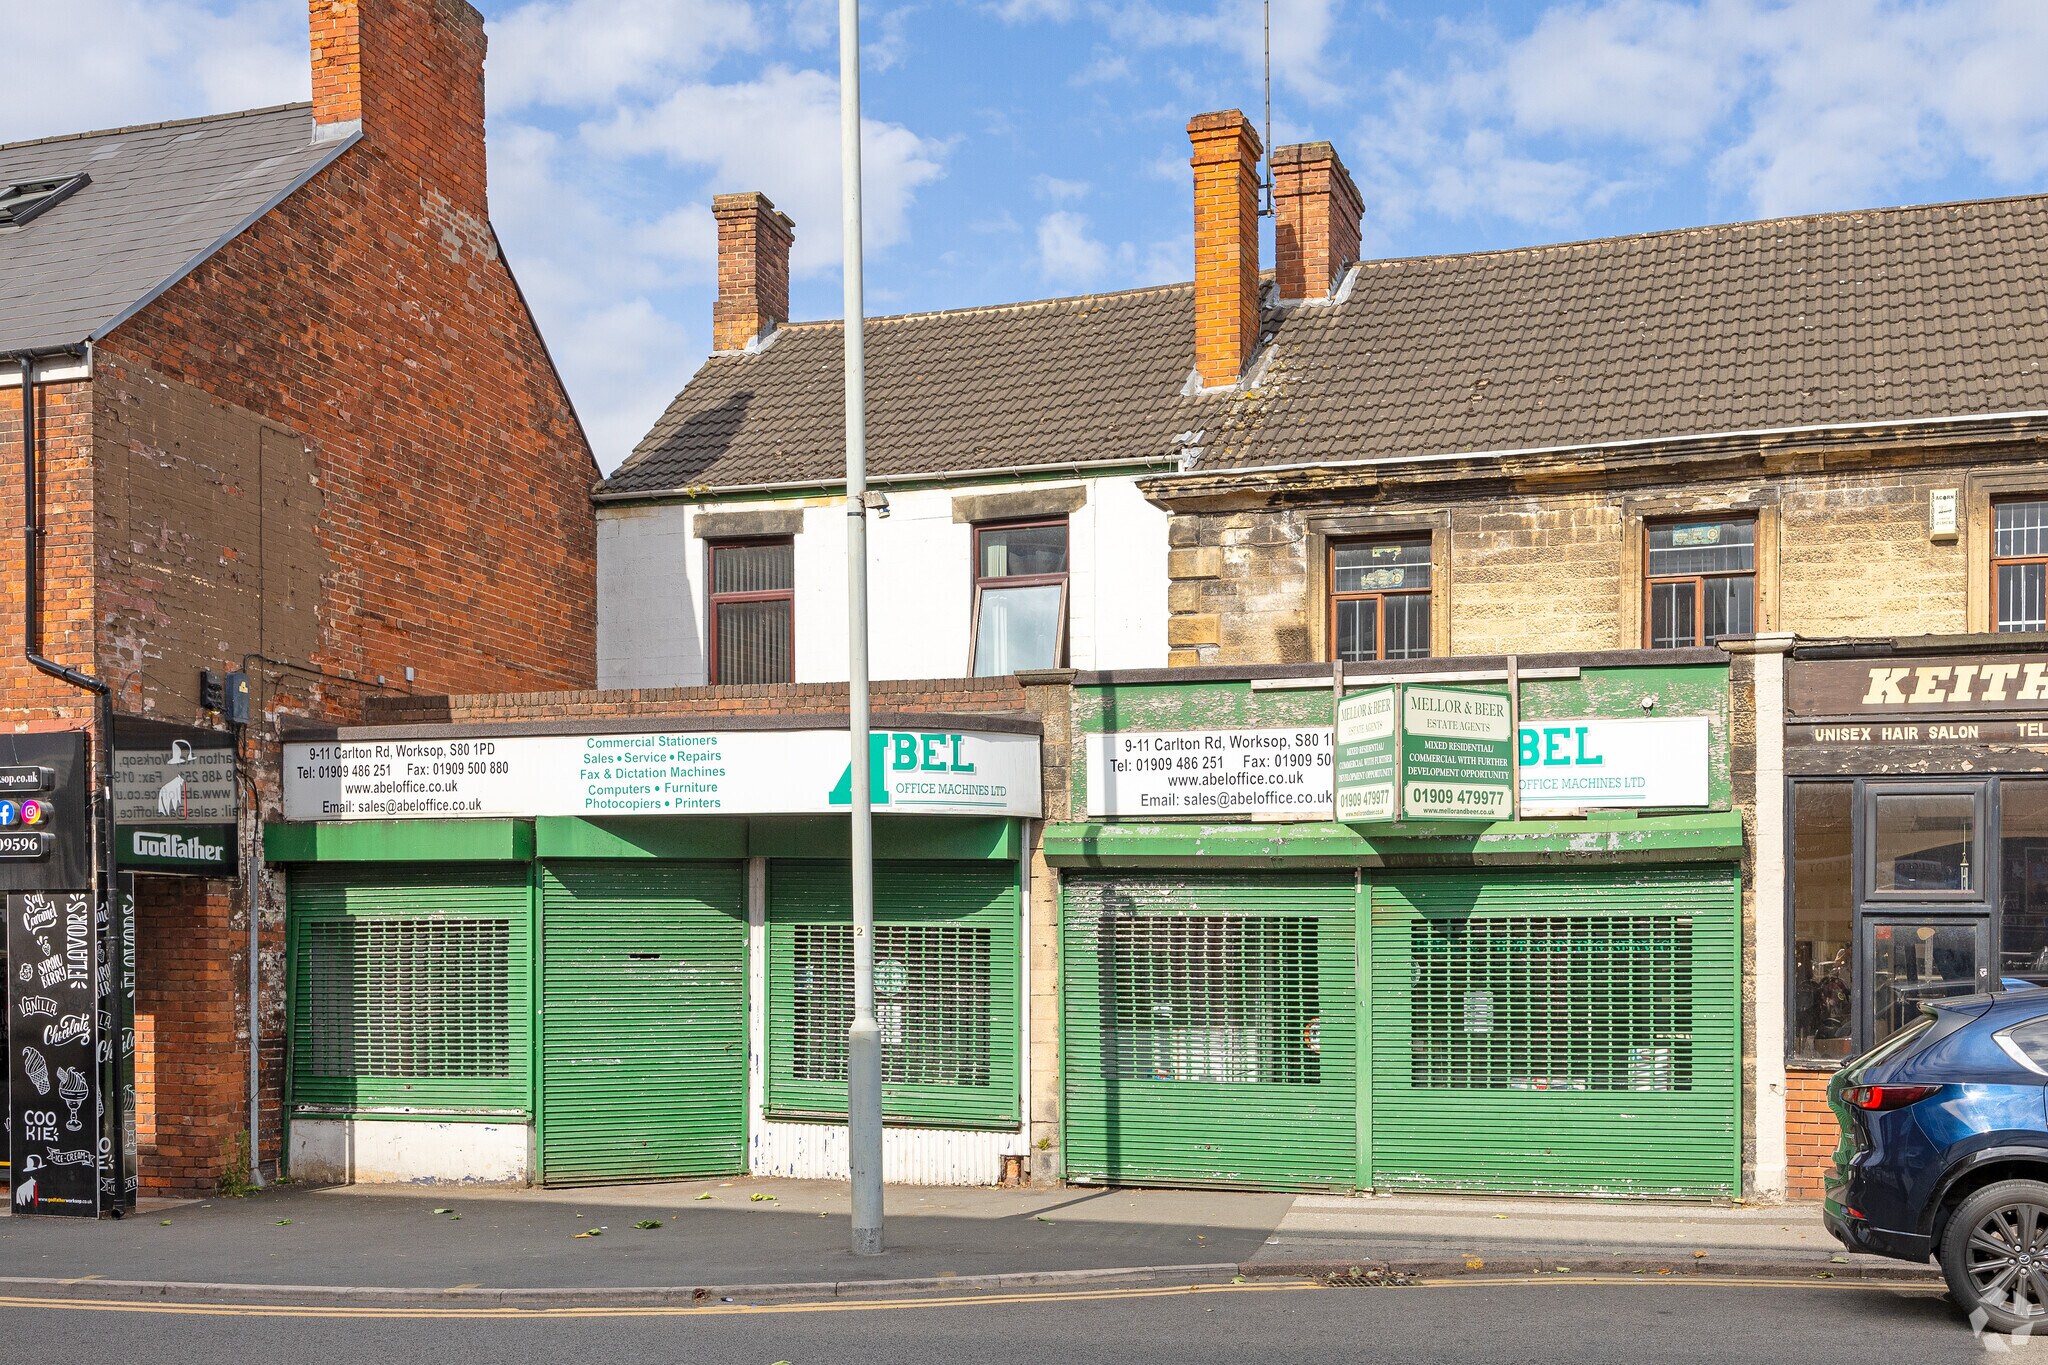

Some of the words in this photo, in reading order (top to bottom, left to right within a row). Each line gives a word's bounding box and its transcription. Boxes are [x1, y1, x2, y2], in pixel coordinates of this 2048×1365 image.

[1862, 662, 2048, 705] KEITH
[1341, 702, 1367, 722] MELLOR
[1368, 702, 1373, 716] &
[1374, 698, 1391, 714] BEER
[1411, 696, 1462, 713] MELLOR
[1464, 701, 1472, 714] &
[1474, 702, 1504, 718] BEER
[1427, 718, 1458, 730] ESTATE
[1459, 721, 1491, 732] AGENTS
[587, 736, 655, 748] Commercial
[658, 735, 718, 746] Stationers
[1814, 727, 1872, 742] UNISEX
[1881, 726, 1919, 740] HAIR
[1928, 725, 1979, 740] SALON
[309, 747, 330, 760] 9-11
[334, 746, 372, 760] Carlton
[376, 745, 393, 759] Rd,
[396, 744, 446, 759] Worksop,
[450, 743, 470, 756] S80
[474, 742, 495, 755] 1PD
[1125, 739, 1150, 752] 9-11
[1154, 738, 1200, 751] Carlton
[1204, 736, 1226, 751] Rd,
[1230, 735, 1291, 750] Worksop,
[1296, 734, 1319, 746] S80
[1424, 740, 1448, 750] MIXED
[1448, 742, 1494, 753] RESIDENTIAL/
[1519, 727, 1603, 766] BEL
[583, 753, 614, 764] Sales
[624, 752, 667, 763] Service
[677, 750, 722, 763] Repairs
[1110, 759, 1132, 772] Tel:
[1136, 758, 1172, 772] 01909
[1176, 756, 1198, 770] 486
[1202, 756, 1223, 769] 251
[1243, 754, 1270, 768] Fax:
[1274, 754, 1312, 767] 01909
[1316, 752, 1334, 766] 50
[1409, 752, 1456, 764] COMMERCIAL
[1458, 756, 1476, 765] WITH
[1478, 756, 1508, 767] FURTHER
[297, 766, 316, 779] Tel:
[318, 765, 349, 778] 01909
[352, 764, 370, 777] 486
[374, 764, 391, 776] 251
[407, 763, 430, 776] Fax:
[433, 762, 464, 775] 01909
[468, 762, 486, 774] 500
[490, 761, 508, 774] 880
[580, 769, 600, 780] Fax
[603, 768, 612, 779] &
[616, 768, 667, 779] Dictation
[670, 766, 726, 778] Machines
[1408, 766, 1460, 777] DEVELOPMENT
[1460, 769, 1510, 780] OPPORTUNITY
[0, 771, 38, 786] sop.co.uk
[1168, 771, 1304, 786] www.abeloffice.co.uk
[1519, 778, 1559, 790] OFFICE
[1562, 777, 1622, 789] MACHINES
[1624, 776, 1646, 788] LTD
[345, 780, 458, 794] www.abeloffice.co.uk
[588, 784, 651, 797] Computers
[664, 782, 718, 793] Furniture
[896, 782, 935, 794] OFFICE
[938, 783, 989, 796] MACHINES
[990, 785, 1007, 797] LTD
[586, 798, 661, 811] Photocopiers
[676, 798, 721, 808] Printers
[1141, 793, 1179, 806] Email:
[1184, 790, 1333, 808] sales@abeloffice.co.uk
[1340, 793, 1362, 808] 01909
[1363, 789, 1390, 806] 479977
[1413, 788, 1453, 804] 01909
[1457, 789, 1504, 806] 479977
[322, 800, 355, 813] Email:
[358, 798, 482, 815] sales@abeloffice.co.uk
[1423, 808, 1495, 816] www.mellorandbeer.co.uk
[133, 832, 224, 861] Godfather
[23, 900, 58, 932] Caramel
[856, 927, 863, 936] 2
[66, 901, 88, 980] FLAVORS
[40, 966, 67, 988] BERRY
[18, 995, 58, 1016] VANILLA
[44, 1013, 90, 1046] Chocolate
[24, 1110, 56, 1126] COO
[26, 1126, 54, 1141] KIE
